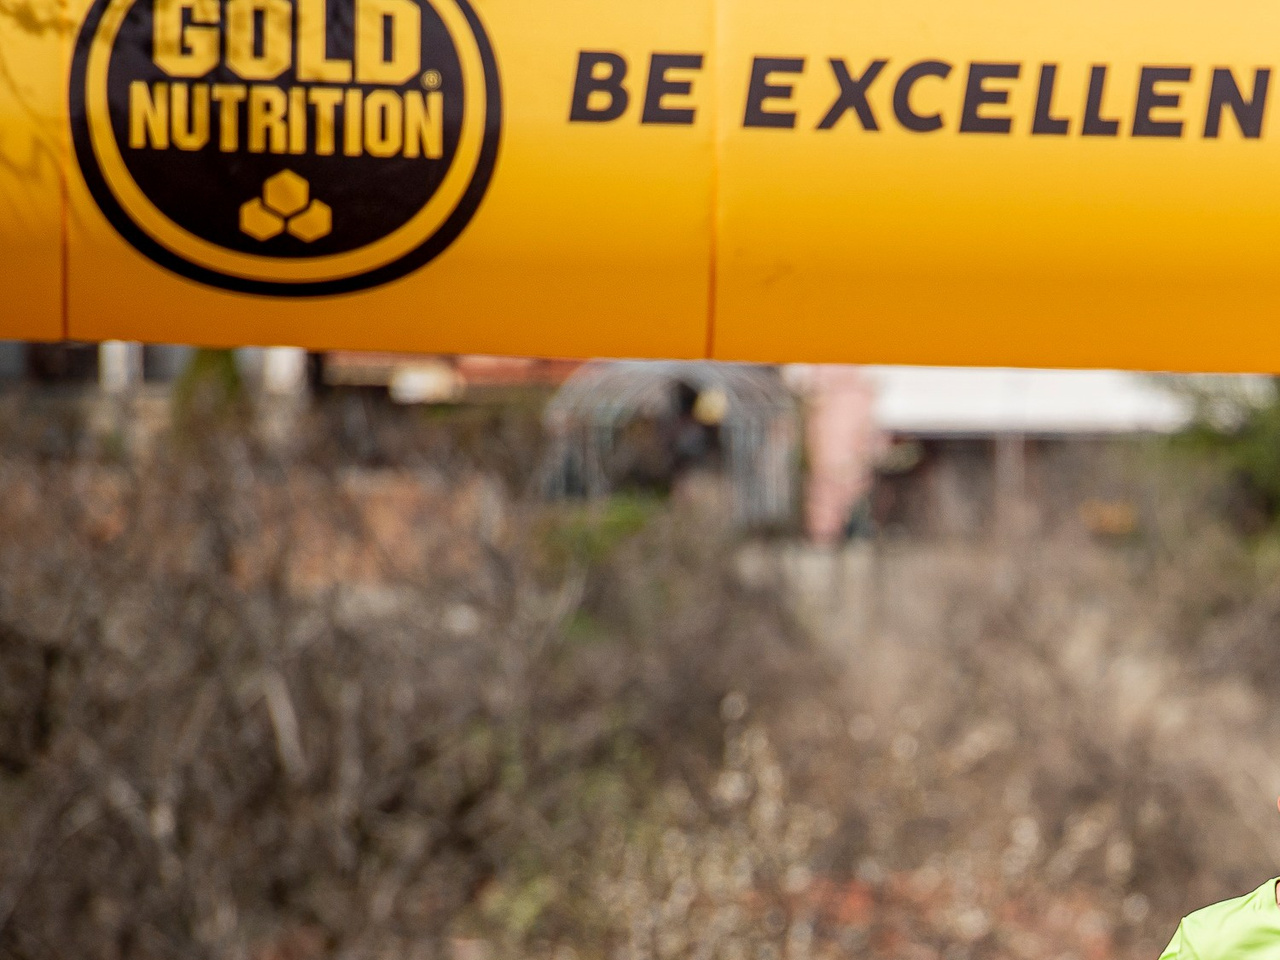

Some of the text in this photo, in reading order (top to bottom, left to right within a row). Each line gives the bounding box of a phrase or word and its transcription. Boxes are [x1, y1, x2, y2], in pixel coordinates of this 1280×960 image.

[152, 0, 422, 86] GOLD
[129, 79, 444, 160] NUTRITION
[568, 50, 703, 126] BE
